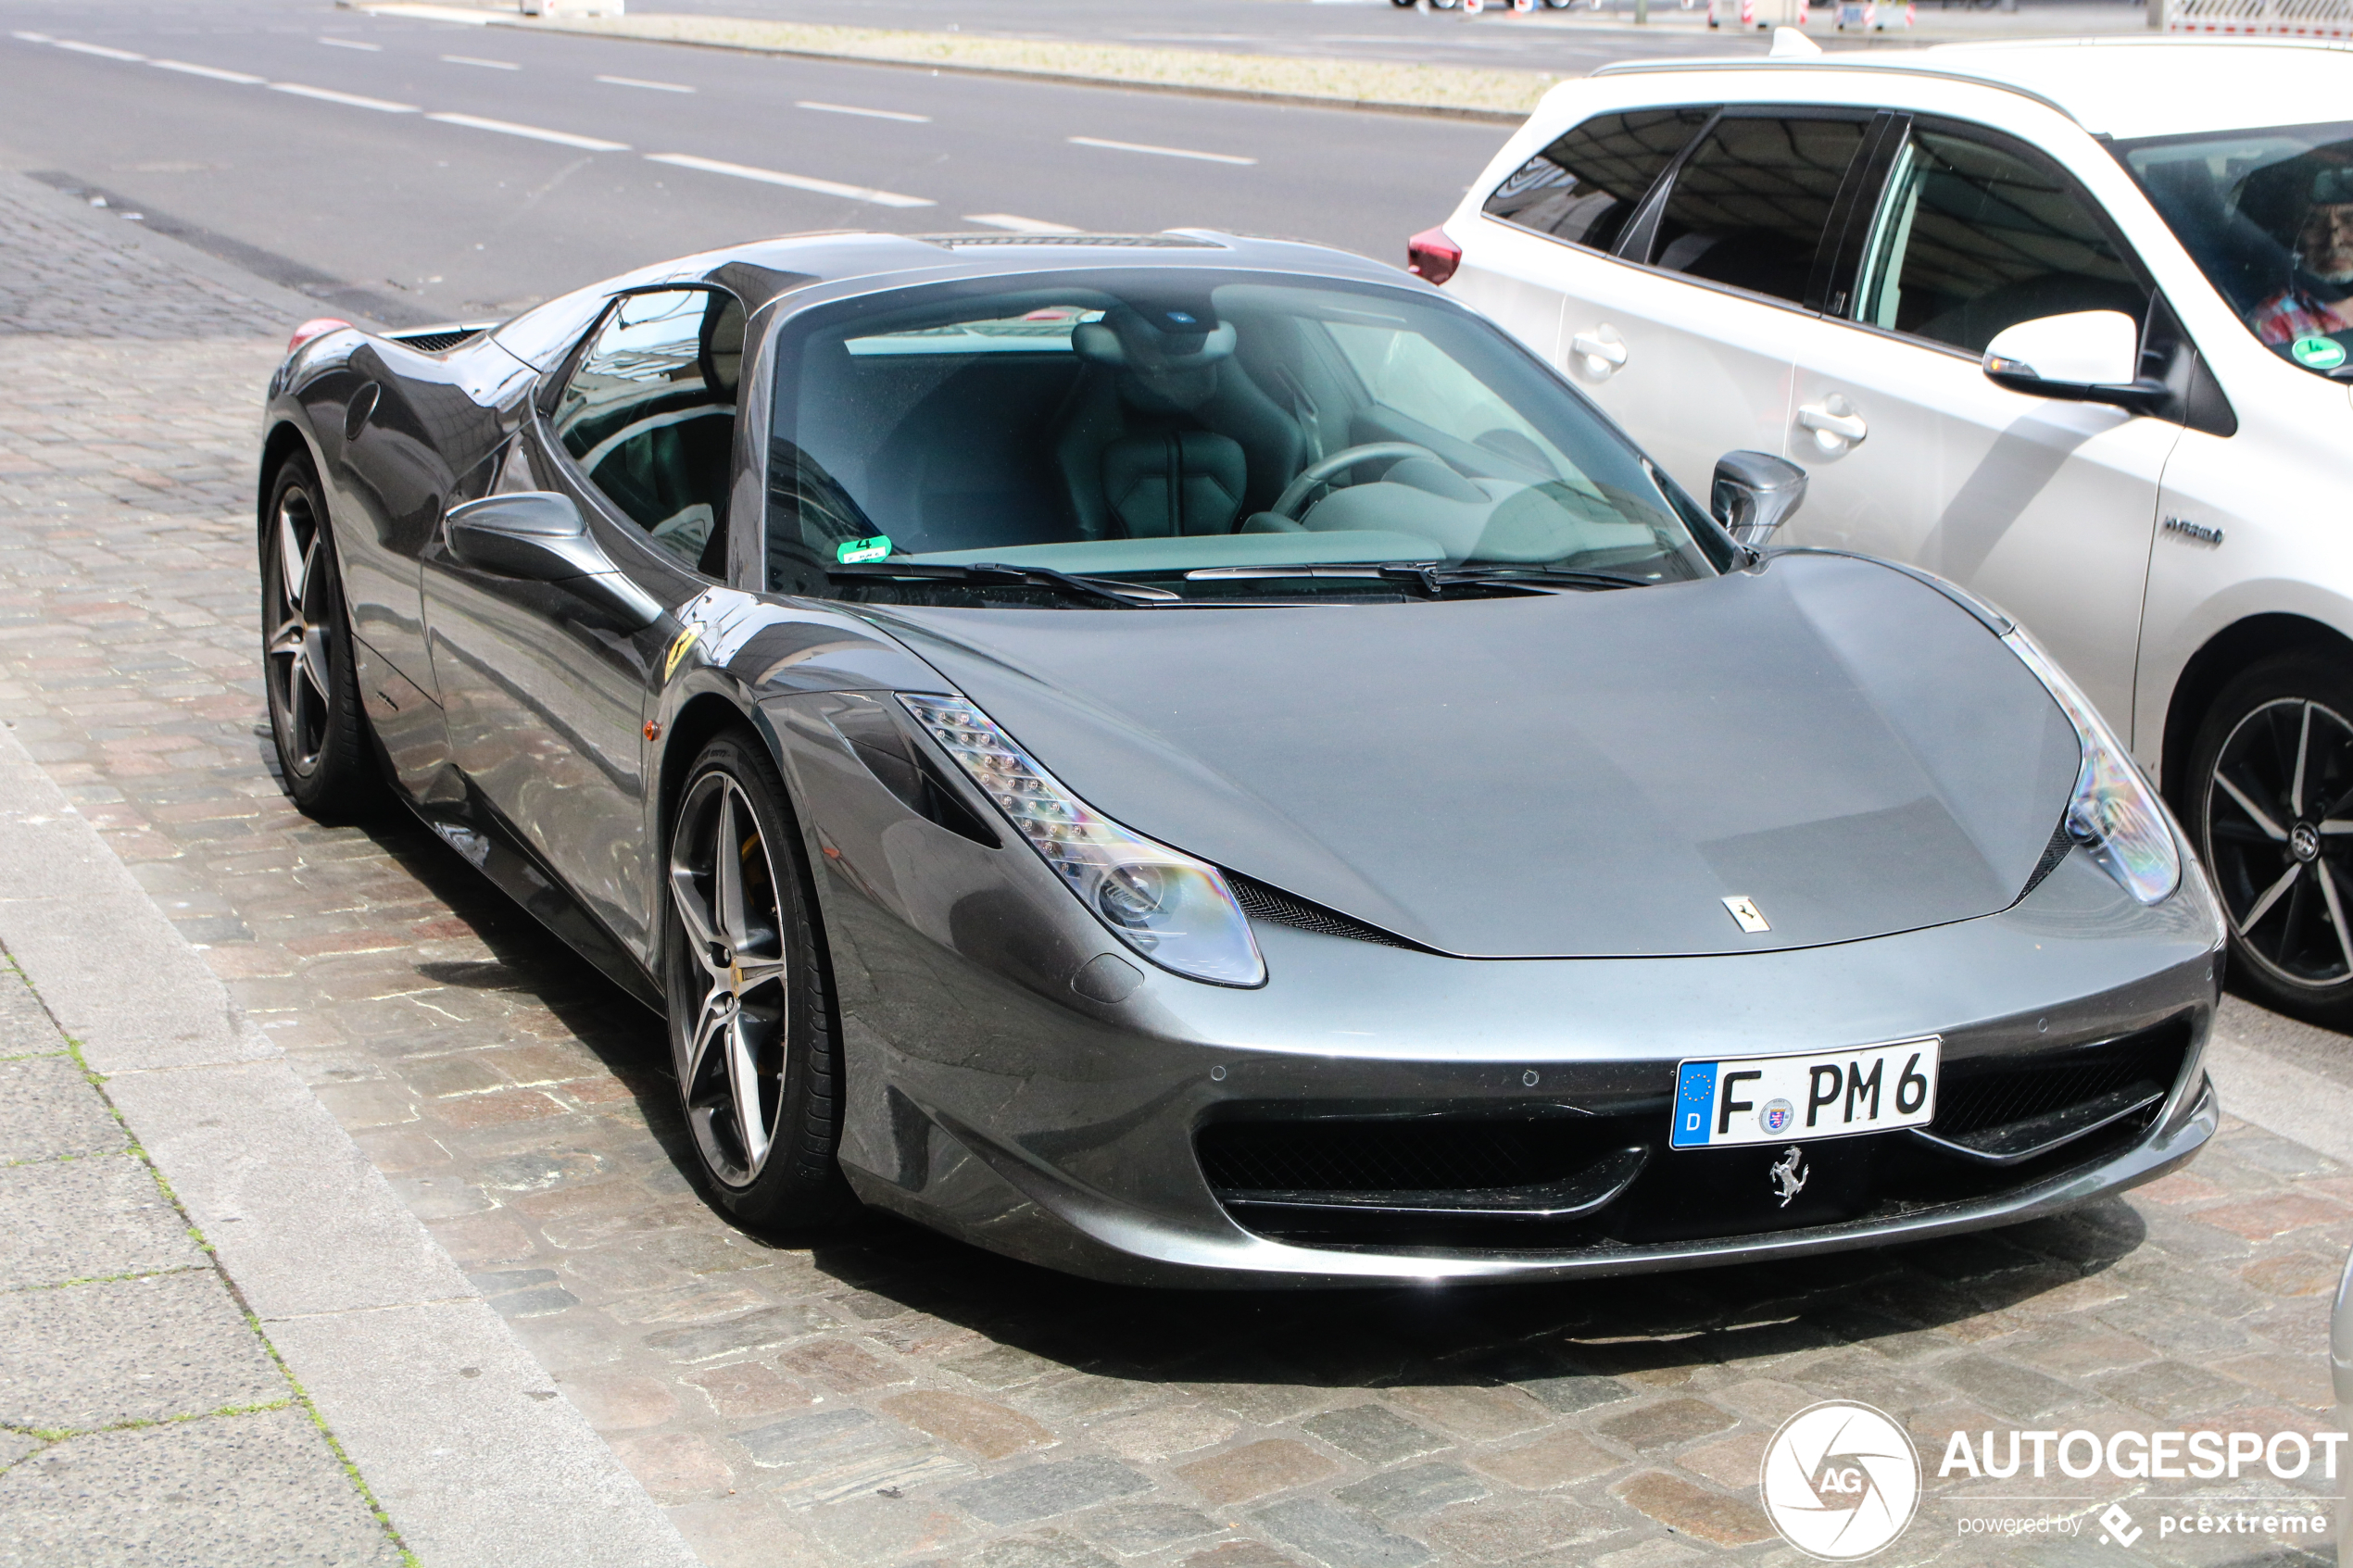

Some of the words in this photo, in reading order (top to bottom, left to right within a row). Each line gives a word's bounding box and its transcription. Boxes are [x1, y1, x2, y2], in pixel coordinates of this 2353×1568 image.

[856, 539, 872, 549] 4
[1718, 1070, 1762, 1135] F
[1685, 1112, 1701, 1132] D
